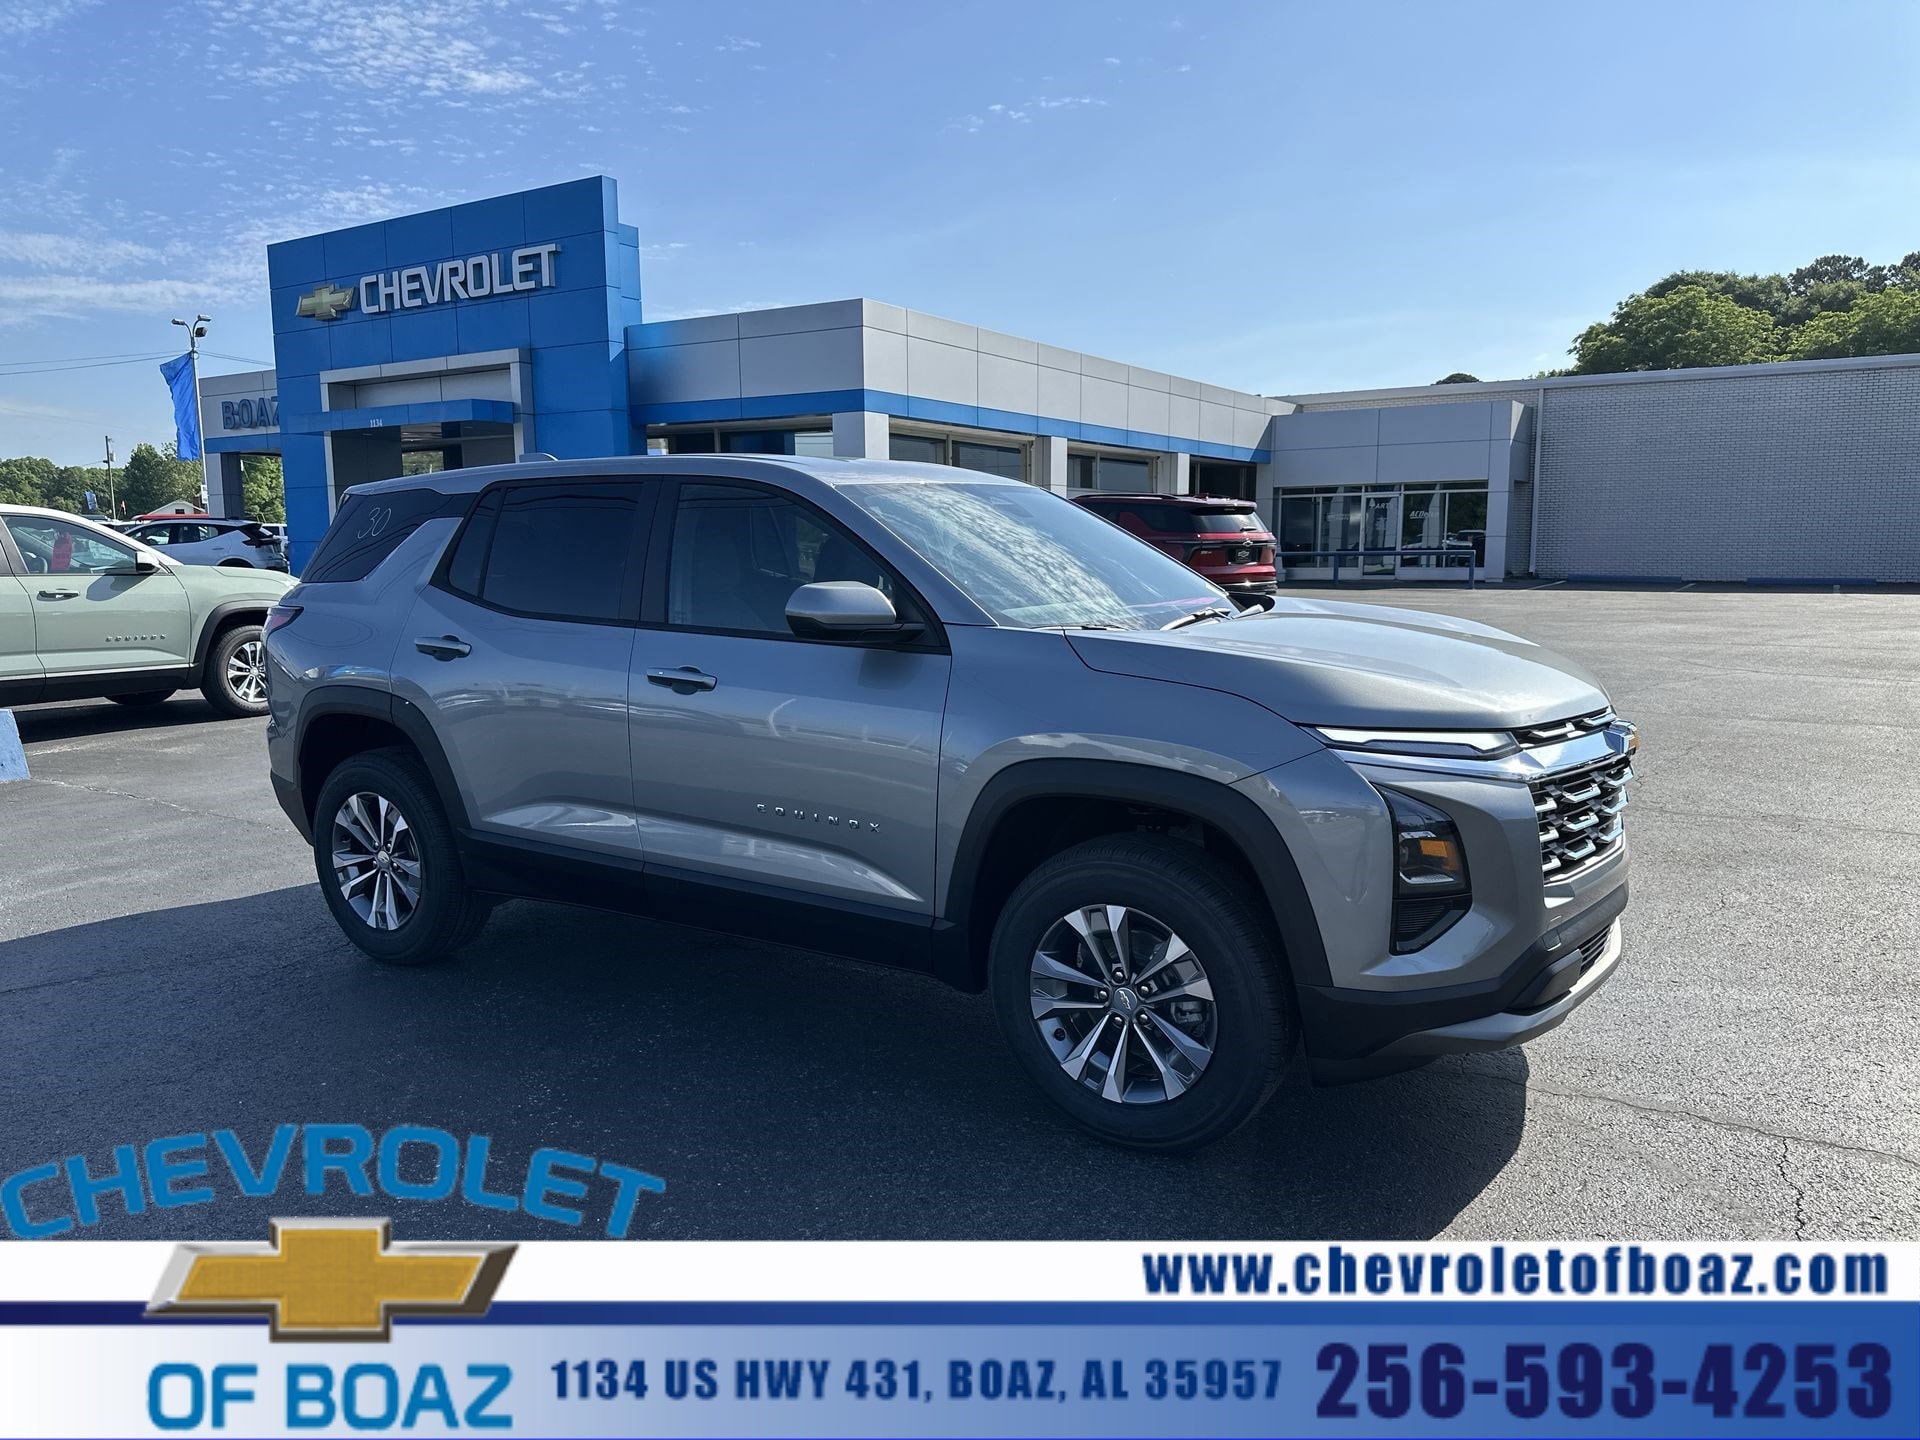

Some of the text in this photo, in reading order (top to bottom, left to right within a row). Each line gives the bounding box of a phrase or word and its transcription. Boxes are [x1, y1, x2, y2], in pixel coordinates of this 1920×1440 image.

[359, 243, 558, 314] CHEVROLET
[357, 507, 392, 539] 30
[756, 803, 881, 833] EQUINOX
